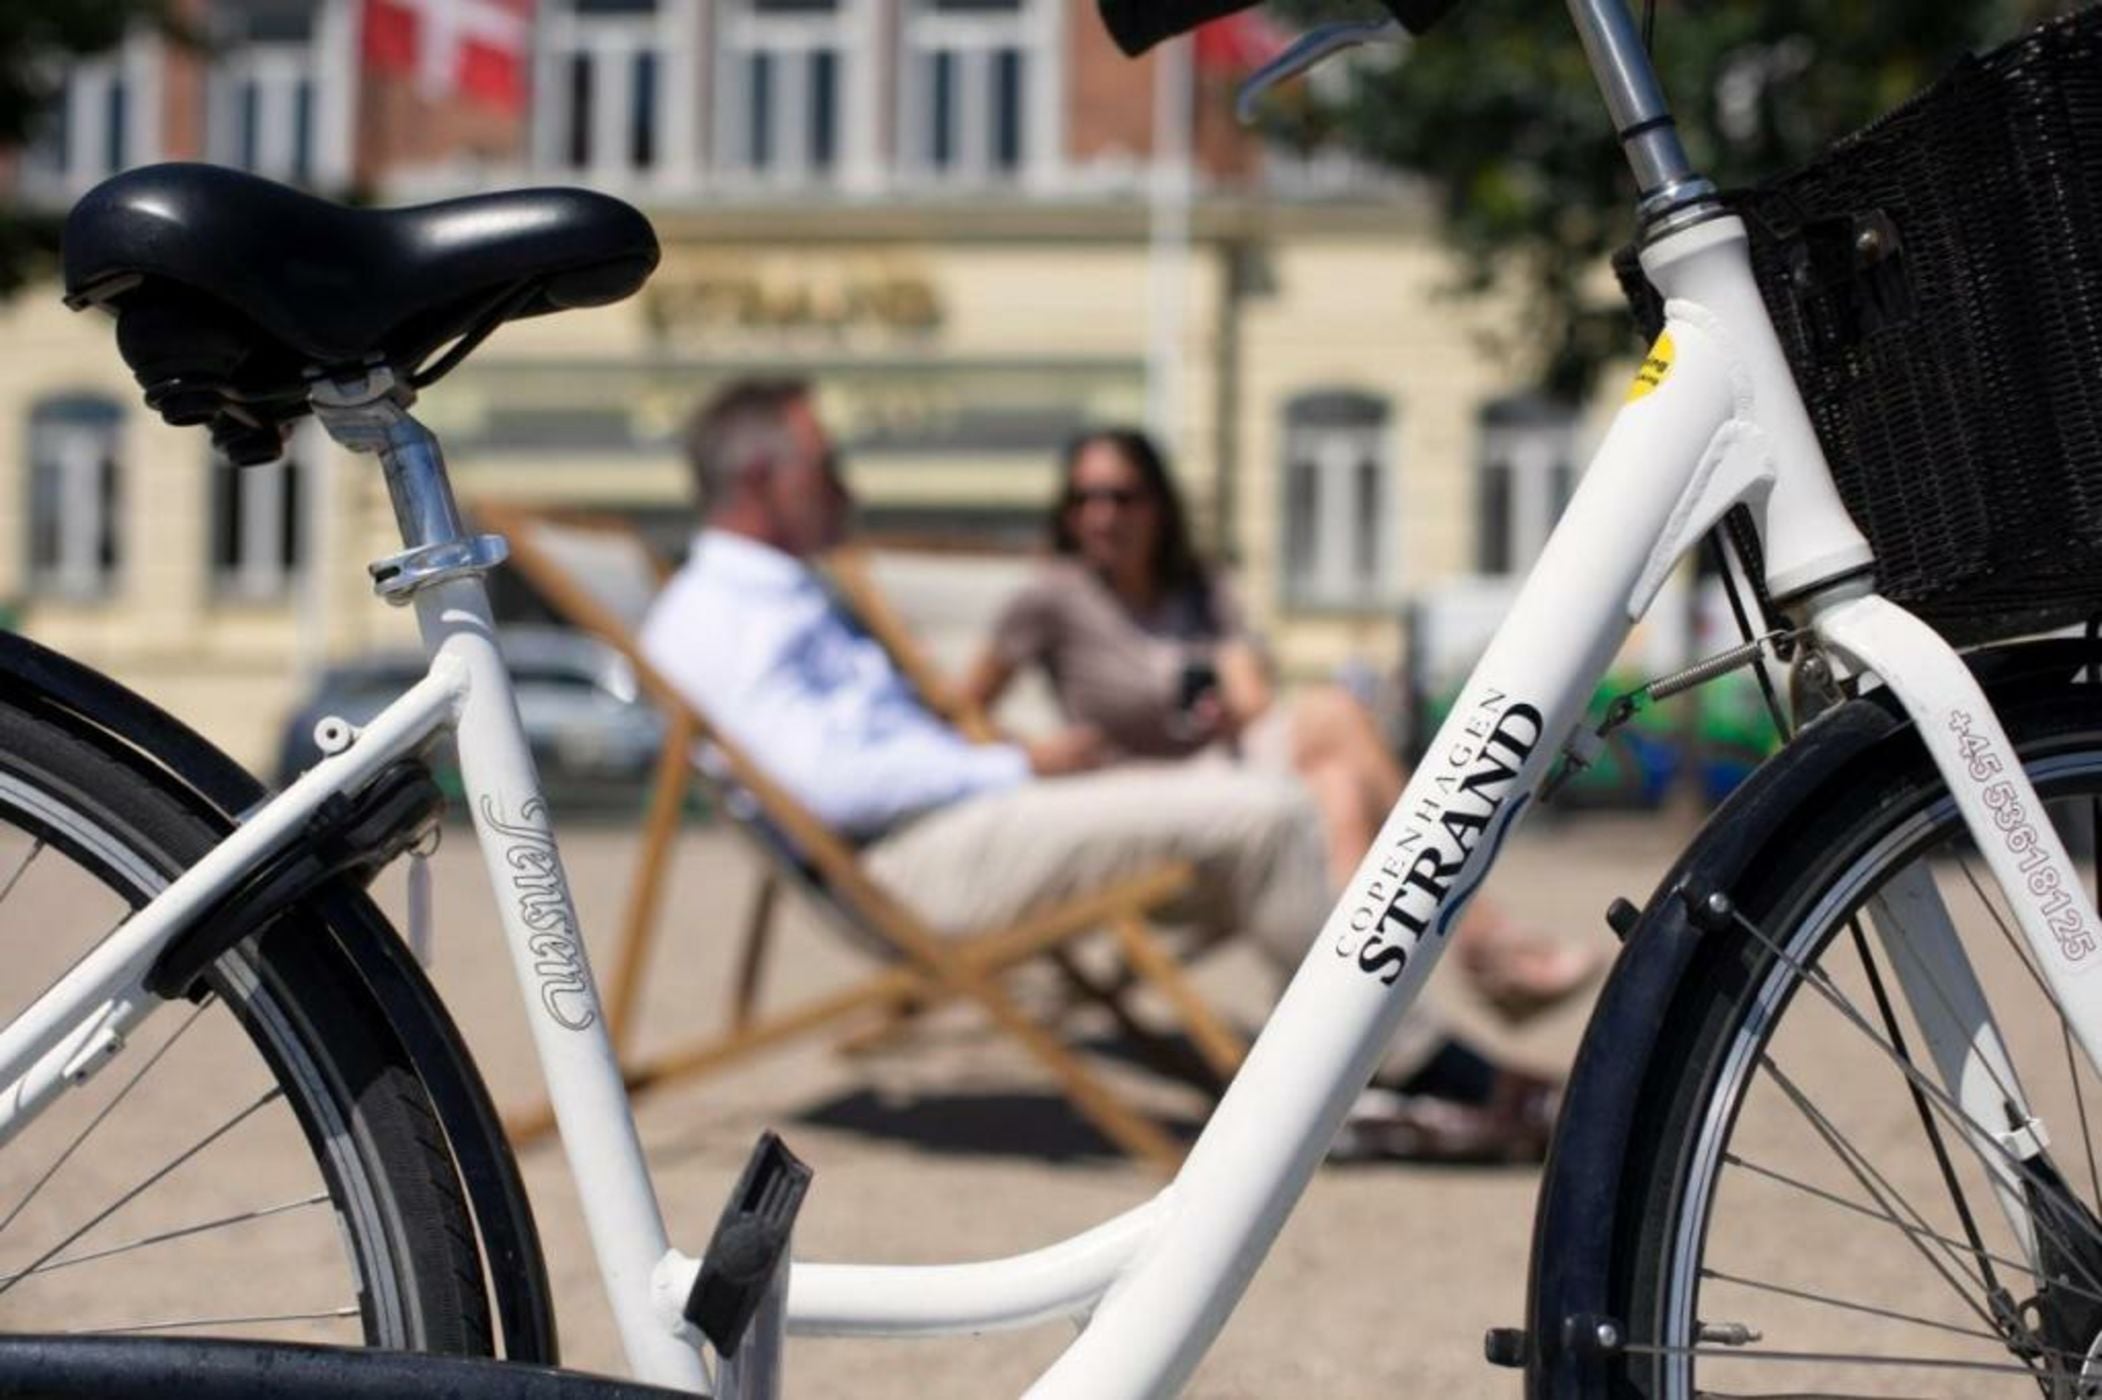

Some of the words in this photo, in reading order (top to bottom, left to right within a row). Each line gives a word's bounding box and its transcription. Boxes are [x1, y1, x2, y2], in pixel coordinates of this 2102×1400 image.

[480, 794, 595, 1031] Jensen
[1336, 687, 1507, 958] COPENHAGEN
[1358, 702, 1544, 987] STRAND
[1949, 709, 2003, 783] +45
[1982, 781, 2097, 962] 53618125
